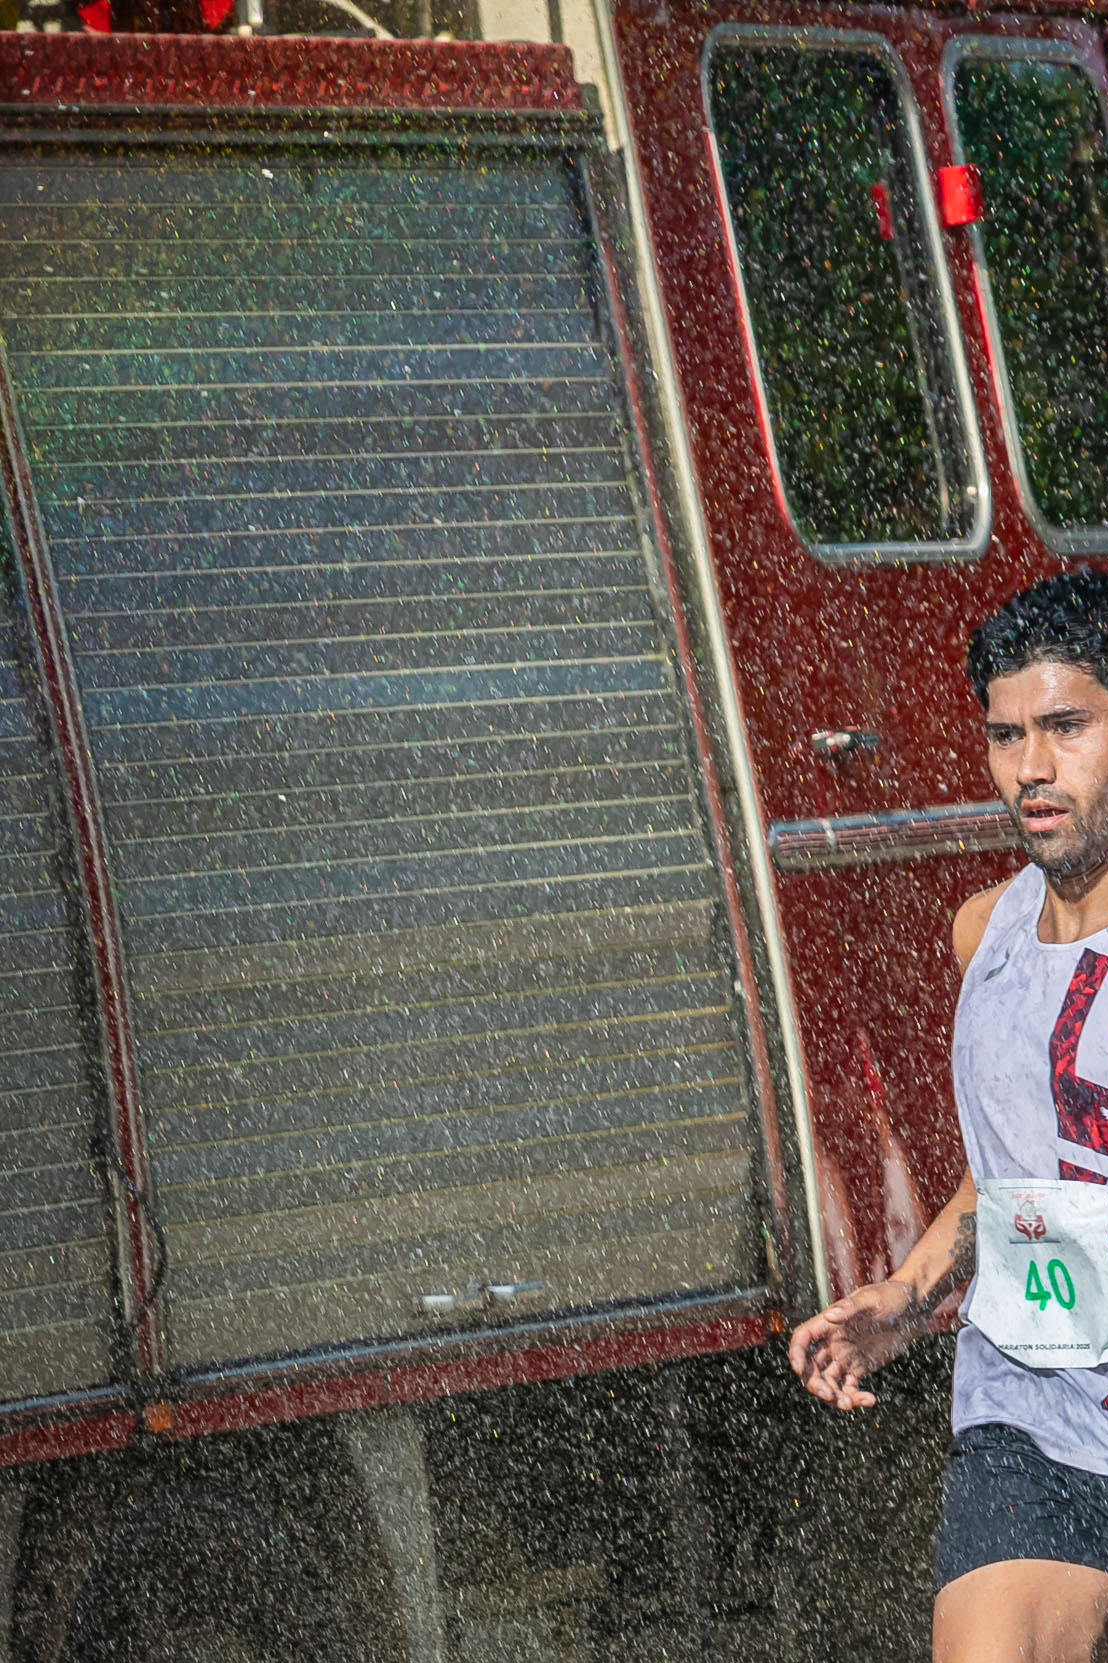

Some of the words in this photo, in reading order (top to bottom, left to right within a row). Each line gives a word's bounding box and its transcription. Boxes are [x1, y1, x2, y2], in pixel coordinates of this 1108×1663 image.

[1025, 1258, 1076, 1311] 40
[998, 1343, 1033, 1351] MARATON
[1035, 1343, 1074, 1351] SOLIDARIA
